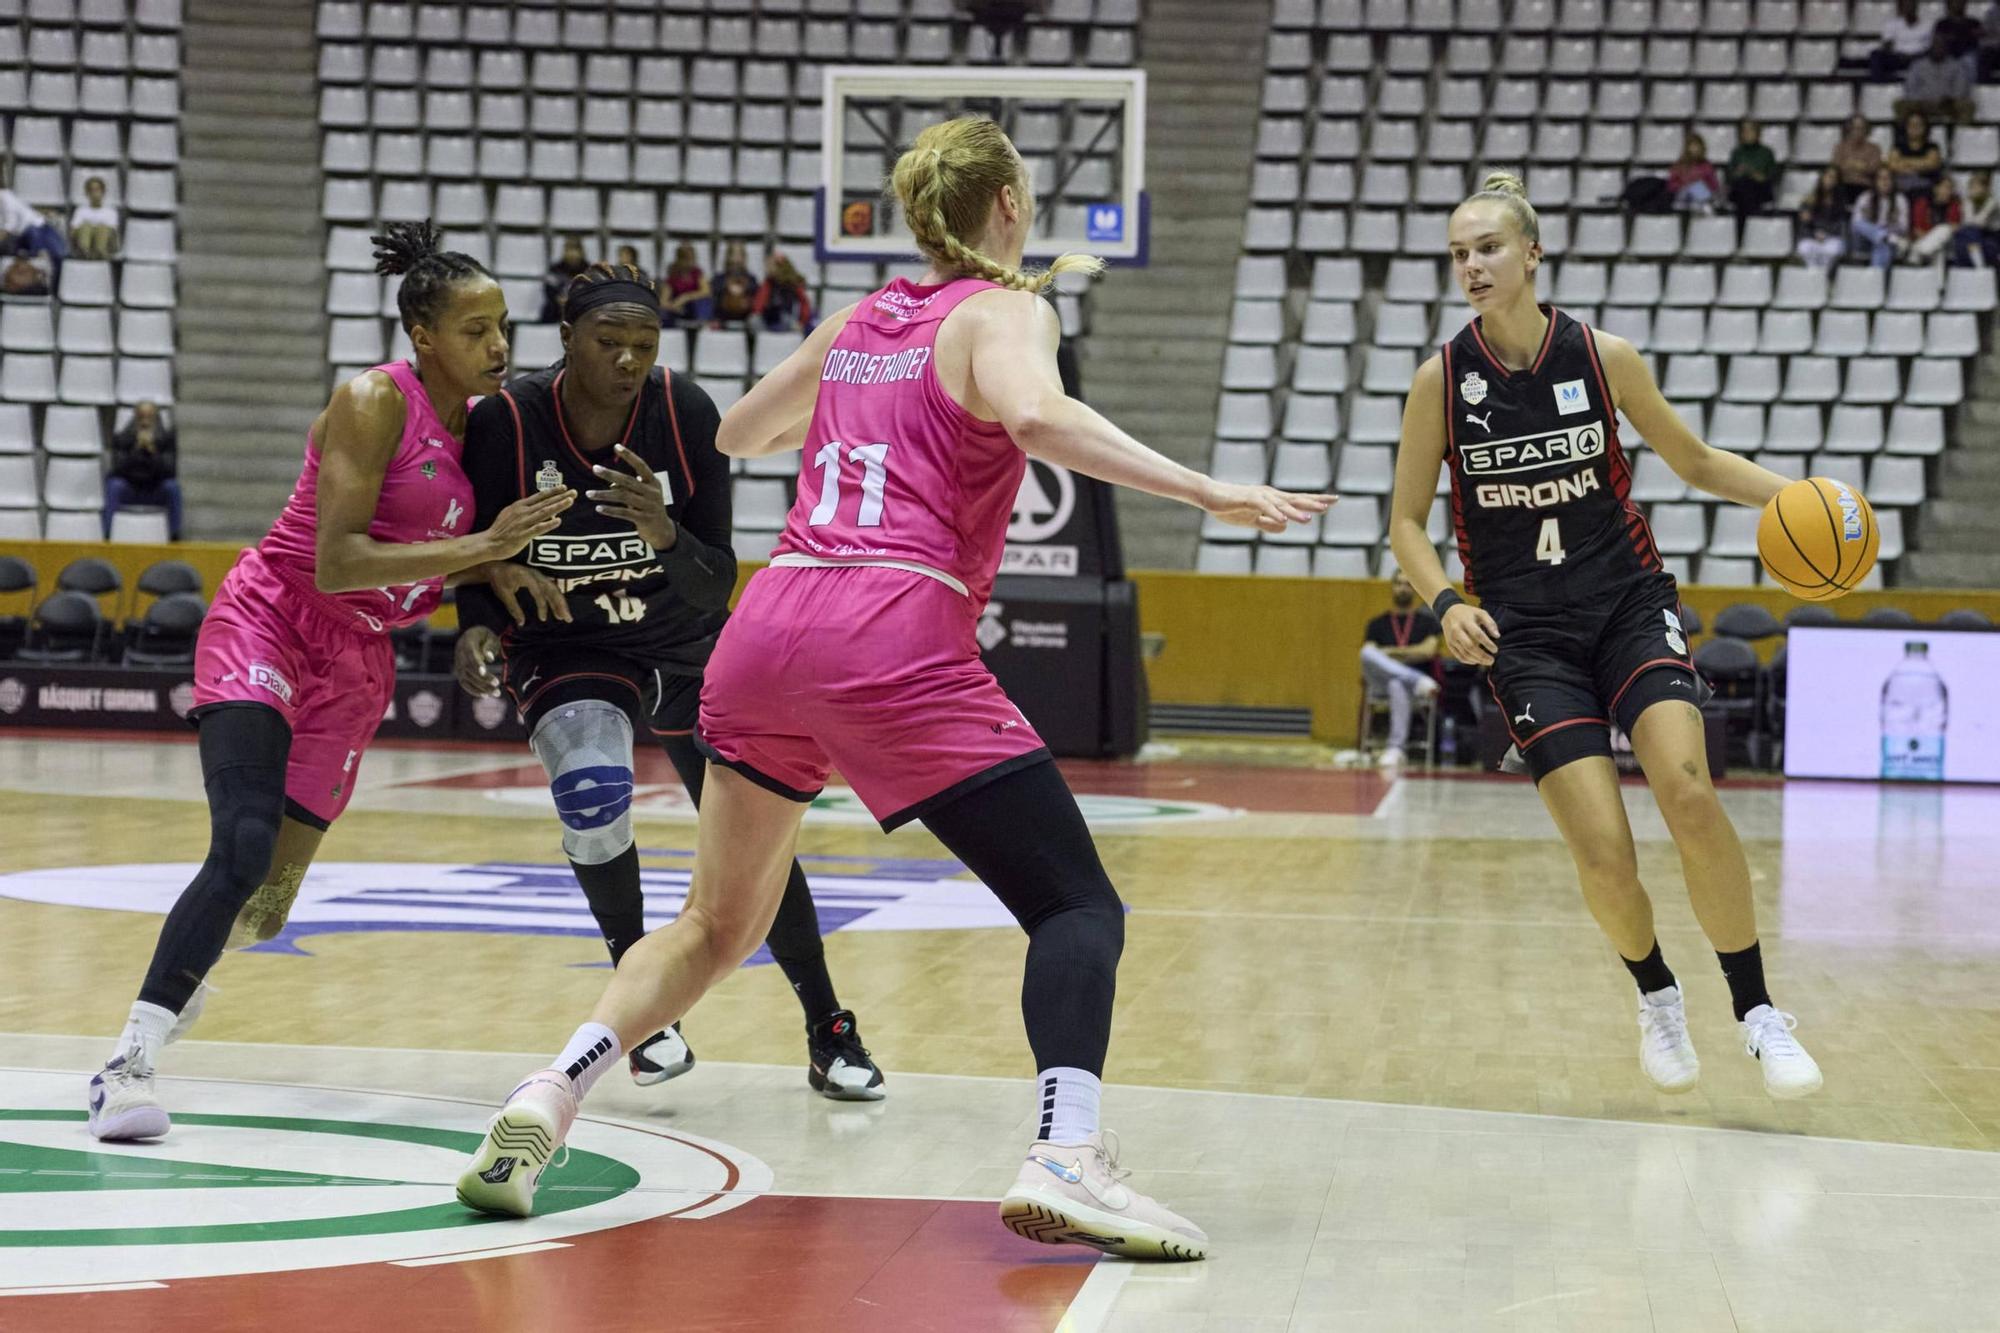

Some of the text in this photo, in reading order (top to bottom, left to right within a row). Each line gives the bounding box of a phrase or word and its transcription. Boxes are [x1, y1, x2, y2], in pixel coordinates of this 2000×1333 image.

[821, 346, 931, 385] DORNSTAUDER
[1469, 436, 1569, 469] SPAR
[808, 440, 890, 527] 11
[1476, 467, 1600, 509] GIRONA
[537, 538, 645, 562] SPAR
[1536, 518, 1566, 566] 4
[1004, 551, 1070, 568] PAR
[556, 564, 664, 594] IRONA
[594, 590, 647, 624] 14
